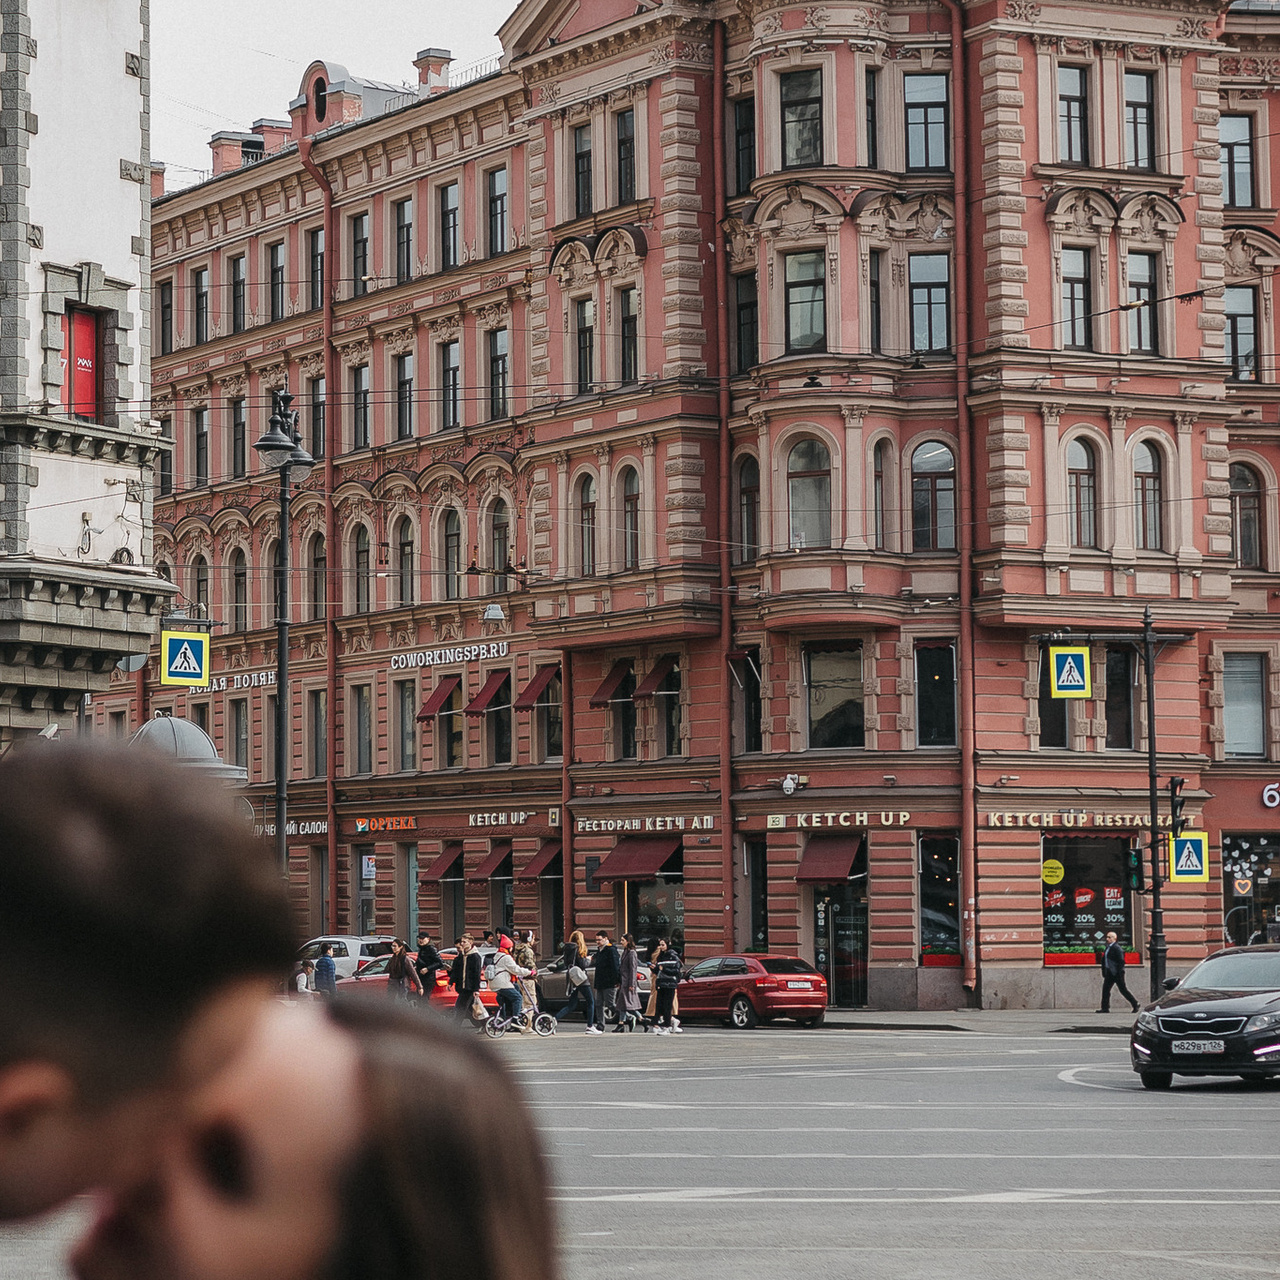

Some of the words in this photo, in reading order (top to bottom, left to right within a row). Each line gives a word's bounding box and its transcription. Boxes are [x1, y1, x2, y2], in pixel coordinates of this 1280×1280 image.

[391, 642, 509, 669] COWORKINGSPB.RU
[234, 671, 276, 689] ПОЛЯН
[370, 816, 416, 831] ОРТЕКА
[469, 812, 507, 826] KETCH
[511, 811, 525, 825] UP
[577, 818, 641, 832] РЕСТОРАН
[645, 816, 685, 831] КЕТЧ
[691, 815, 714, 829] АП
[797, 812, 868, 827] KETCH
[881, 812, 910, 826] UP
[988, 812, 1054, 827] KETCH
[1062, 813, 1088, 827] UP
[1094, 815, 1196, 827] RESTAURAT
[299, 821, 328, 835] САЛОН
[1044, 914, 1065, 923] -10%
[1074, 914, 1095, 923] -20%
[1104, 914, 1125, 923] -30%
[1208, 1041, 1222, 1049] 126
